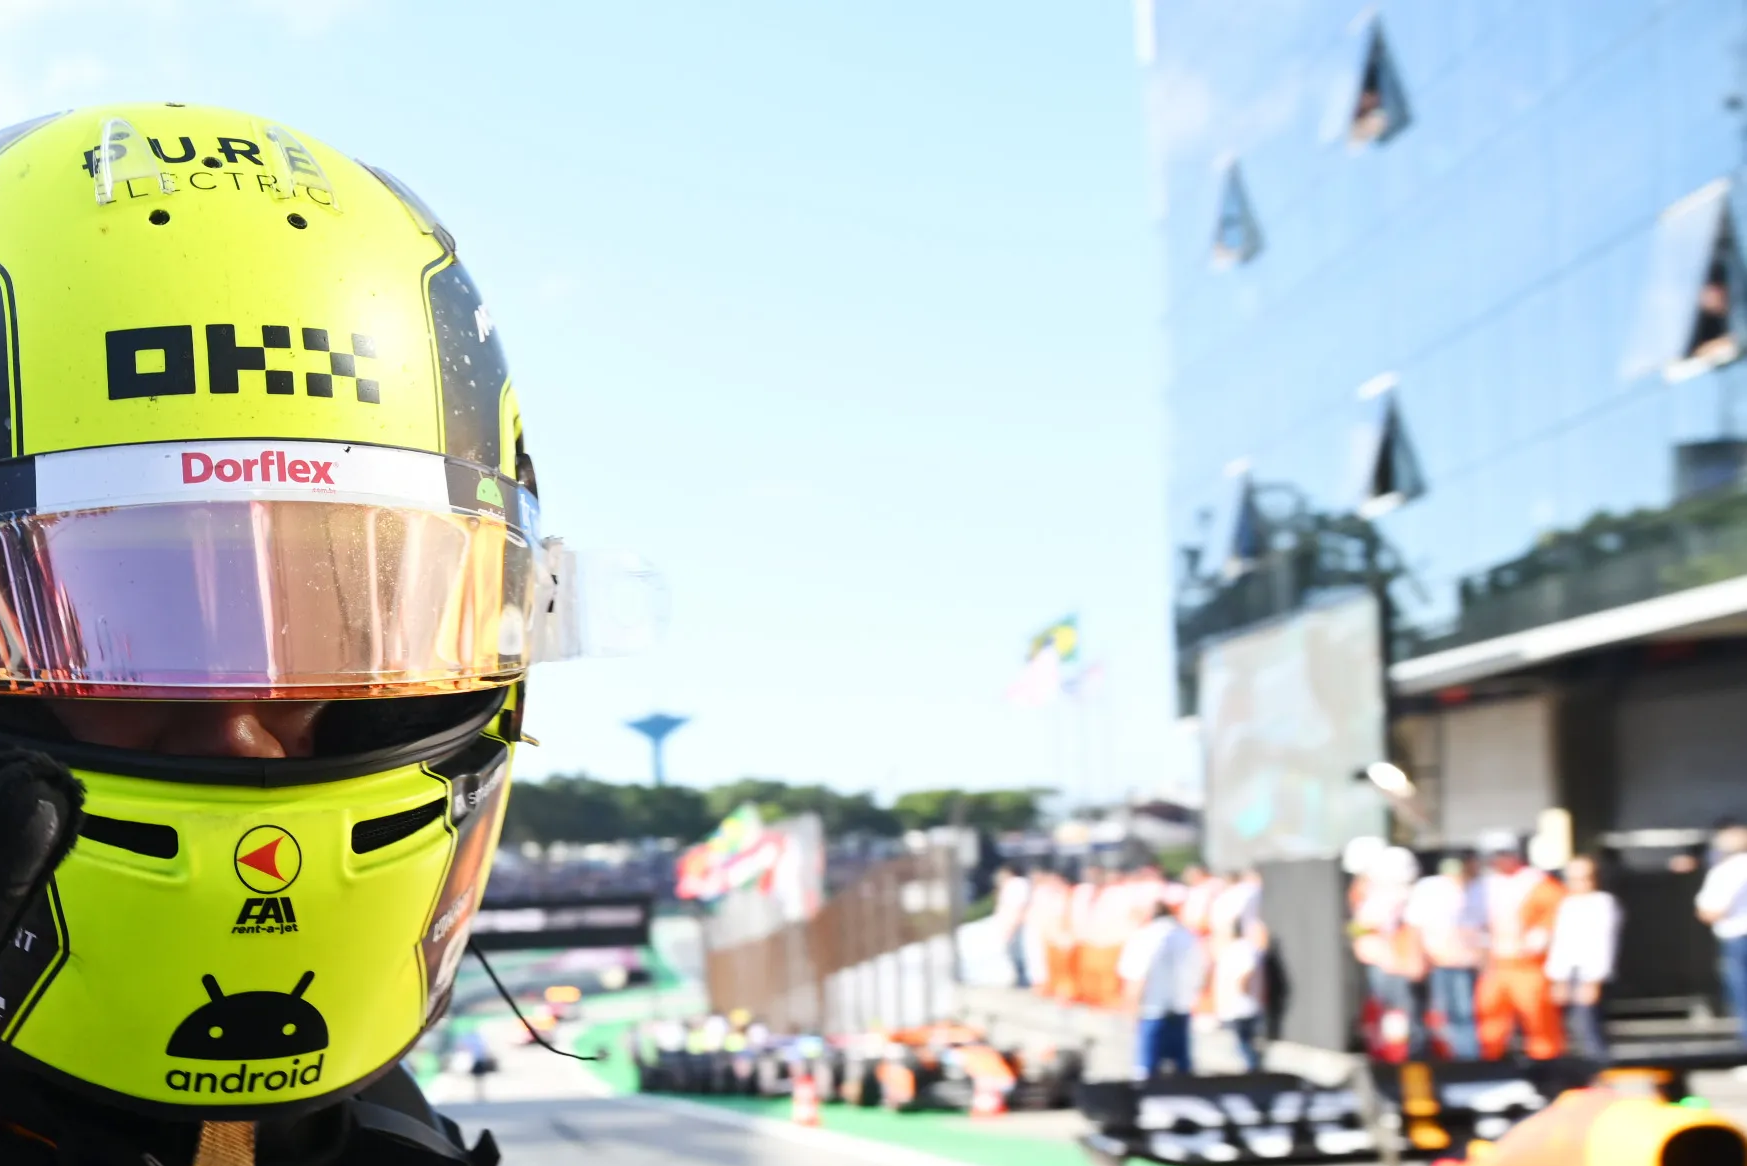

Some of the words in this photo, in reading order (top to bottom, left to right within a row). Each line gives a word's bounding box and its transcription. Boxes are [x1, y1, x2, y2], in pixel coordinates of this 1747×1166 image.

[82, 136, 320, 179] PURE
[105, 324, 381, 404] OKX
[181, 451, 335, 485] Dorflex
[236, 896, 296, 924] FAI
[231, 924, 299, 935] rent-a-jet
[165, 1053, 324, 1094] android
